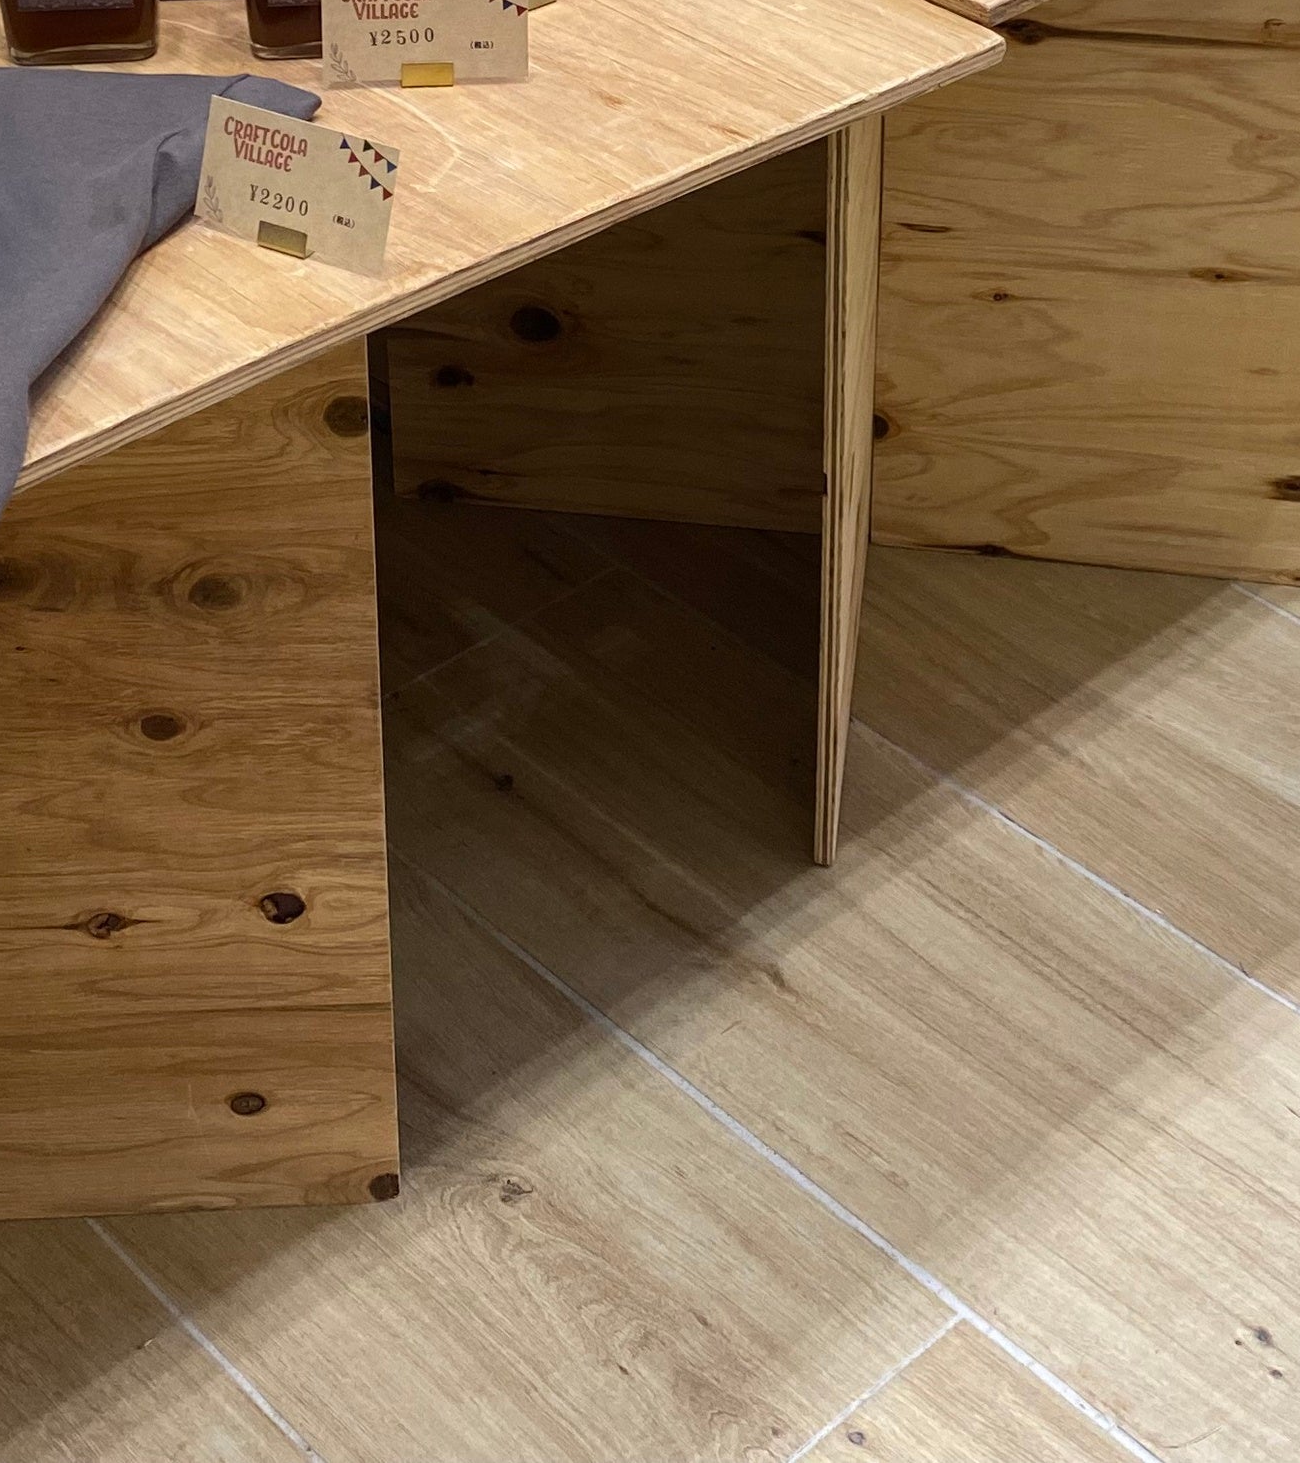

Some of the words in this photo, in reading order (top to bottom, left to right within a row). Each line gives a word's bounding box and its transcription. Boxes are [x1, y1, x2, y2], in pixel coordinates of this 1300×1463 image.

[353, 2, 419, 21] VILLAGE
[369, 27, 435, 47] ¥2500
[469, 40, 495, 50] (税込)
[224, 116, 271, 146] CRAFT
[271, 129, 309, 157] COLA
[234, 137, 294, 172] VILLAGE
[249, 183, 309, 217] ¥2200
[332, 213, 356, 230] (税込)
